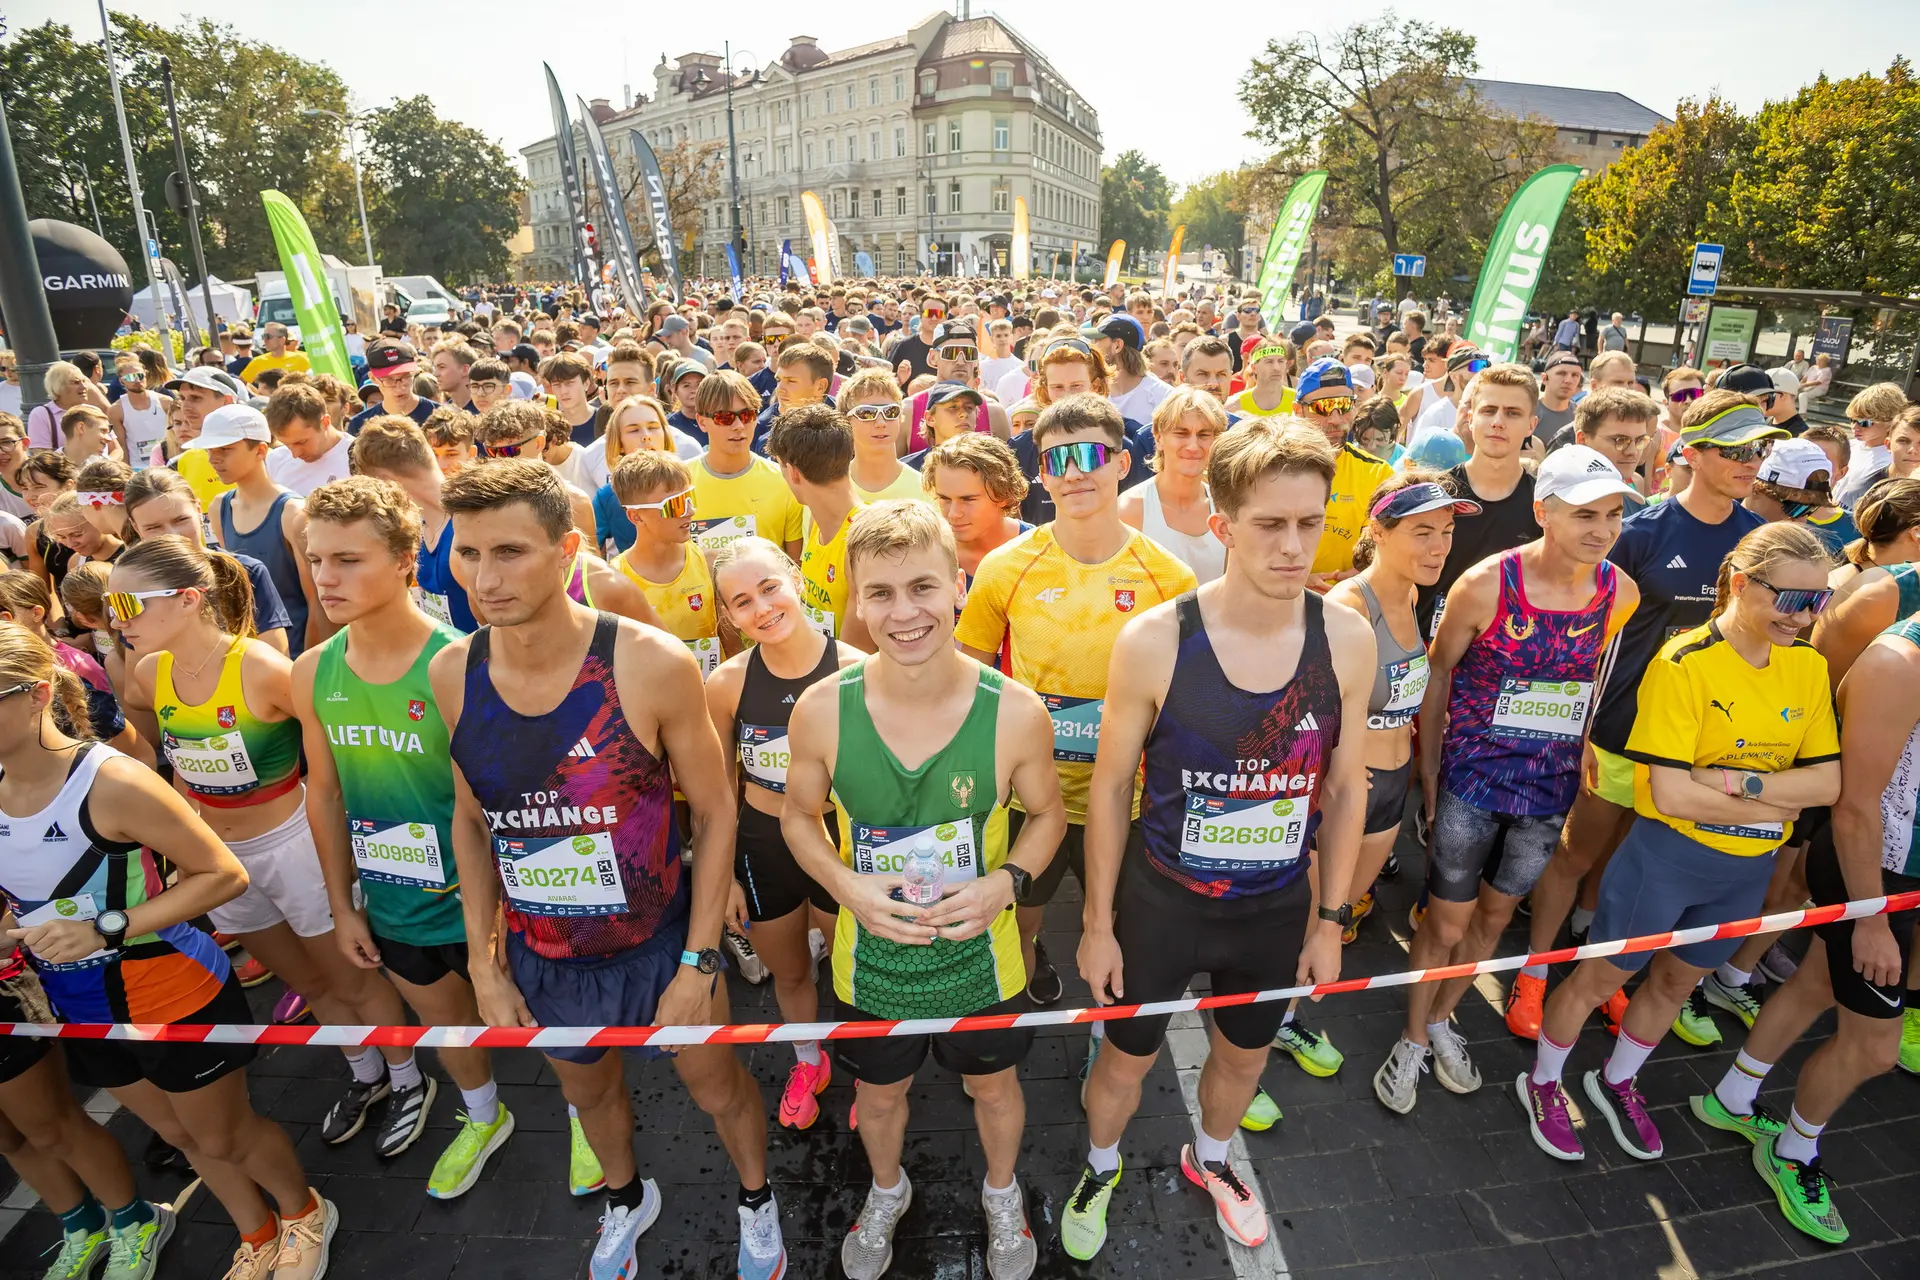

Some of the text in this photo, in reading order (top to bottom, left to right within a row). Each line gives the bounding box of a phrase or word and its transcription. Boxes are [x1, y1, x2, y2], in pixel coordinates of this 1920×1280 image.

[44, 274, 130, 291] GARMIN
[1035, 587, 1065, 604] 4F
[159, 704, 178, 721] 4F
[1511, 700, 1572, 719] 32590
[327, 724, 425, 755] LIETUVA
[176, 755, 230, 773] 32120
[1235, 758, 1270, 772] TOP
[1181, 768, 1317, 792] EXCHANGE
[521, 790, 559, 806] TOP
[1202, 824, 1285, 845] 32630
[367, 842, 426, 864] 30989
[518, 866, 598, 888] 30274
